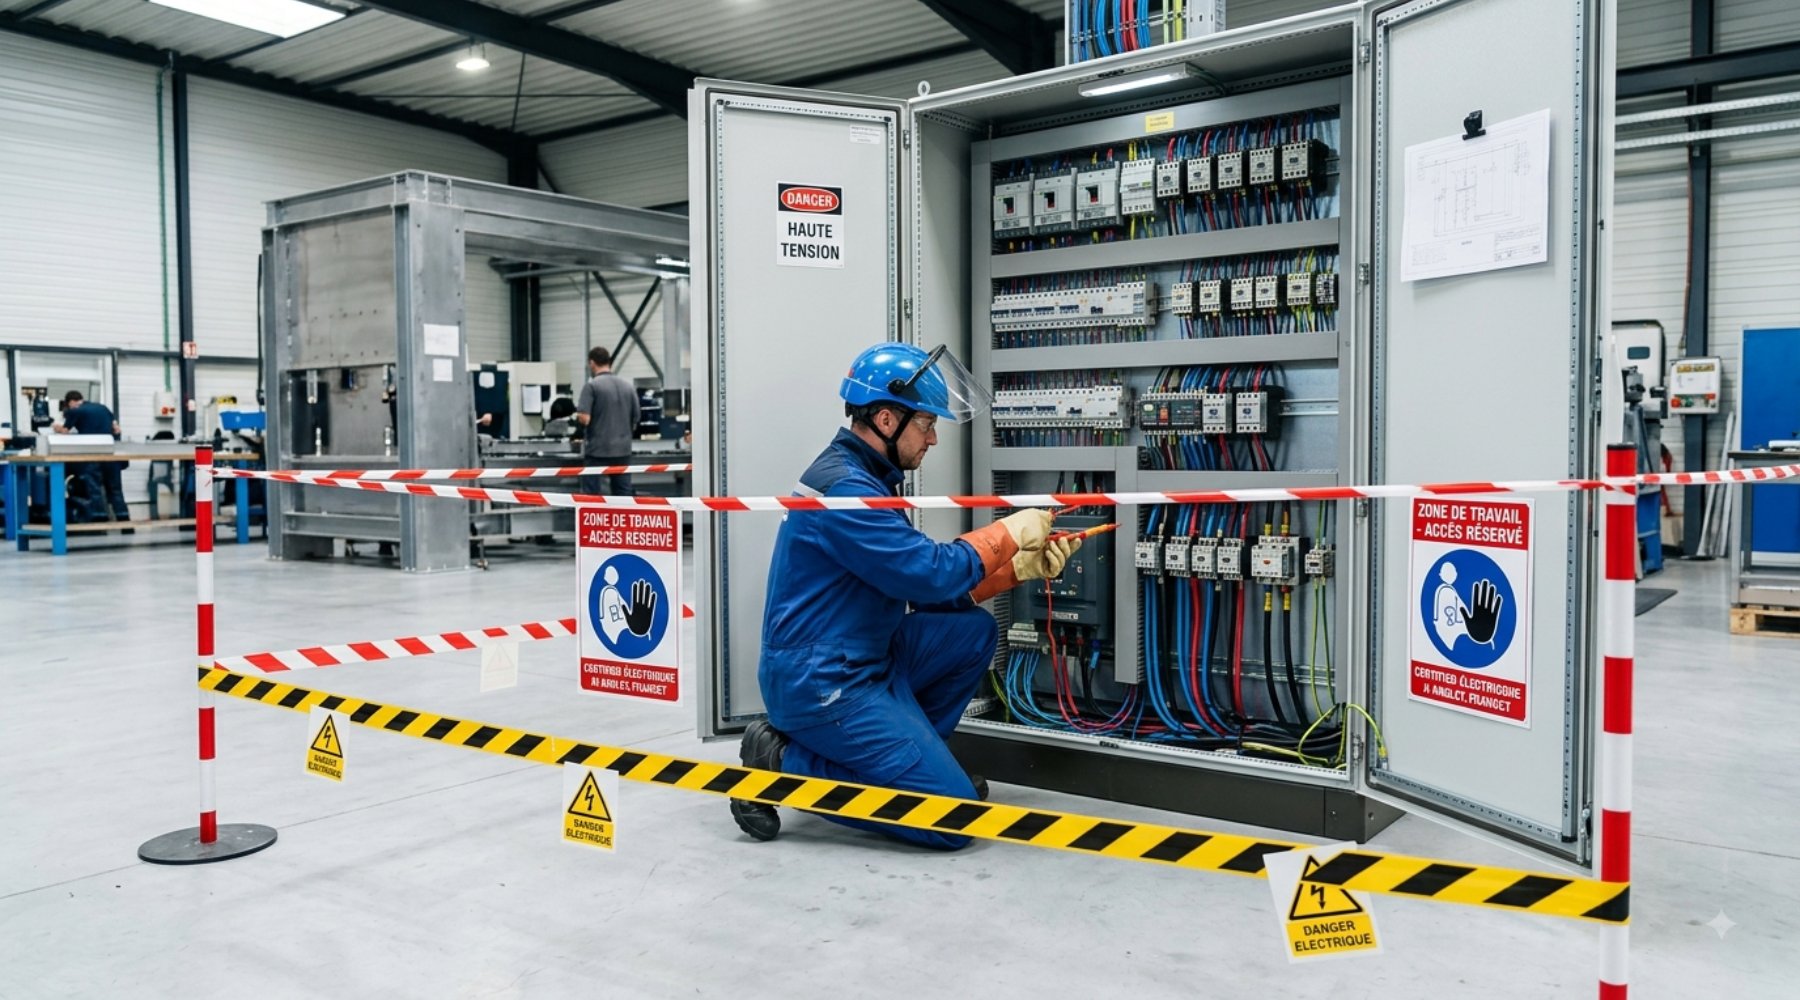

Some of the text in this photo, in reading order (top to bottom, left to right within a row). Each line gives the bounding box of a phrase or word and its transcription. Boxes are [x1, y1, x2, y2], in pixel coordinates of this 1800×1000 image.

[787, 192, 832, 207] DANGER
[788, 222, 832, 238] HAUTE
[781, 243, 839, 260] TENSION
[612, 513, 626, 527] DE
[1418, 503, 1522, 524] ZONE DE TRAVAIL
[1466, 523, 1522, 544] RÉSERVÉ
[1303, 921, 1356, 936] DANGER
[1294, 934, 1373, 952] ELECTRIQUE
